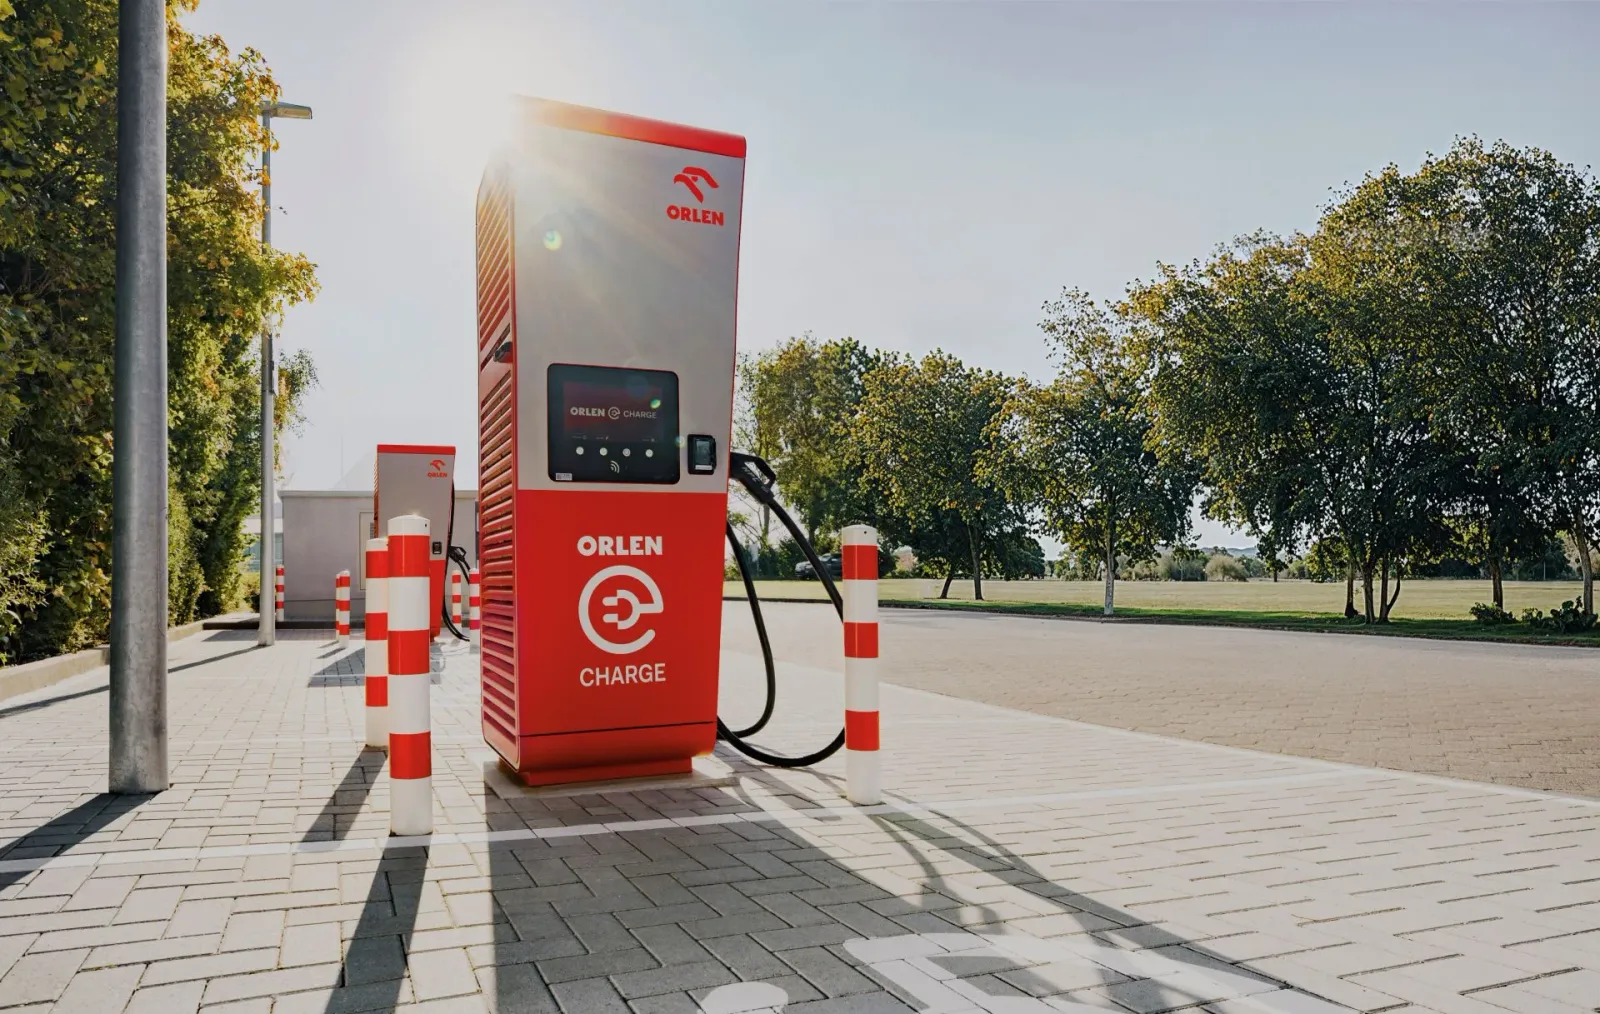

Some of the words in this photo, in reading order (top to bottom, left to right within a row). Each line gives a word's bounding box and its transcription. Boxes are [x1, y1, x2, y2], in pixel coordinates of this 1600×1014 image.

[666, 205, 724, 226] ORLEN
[570, 407, 605, 417] ORLEN
[623, 410, 657, 419] CHARGE
[576, 535, 663, 556] ORLEN
[579, 663, 666, 687] CHARGE
